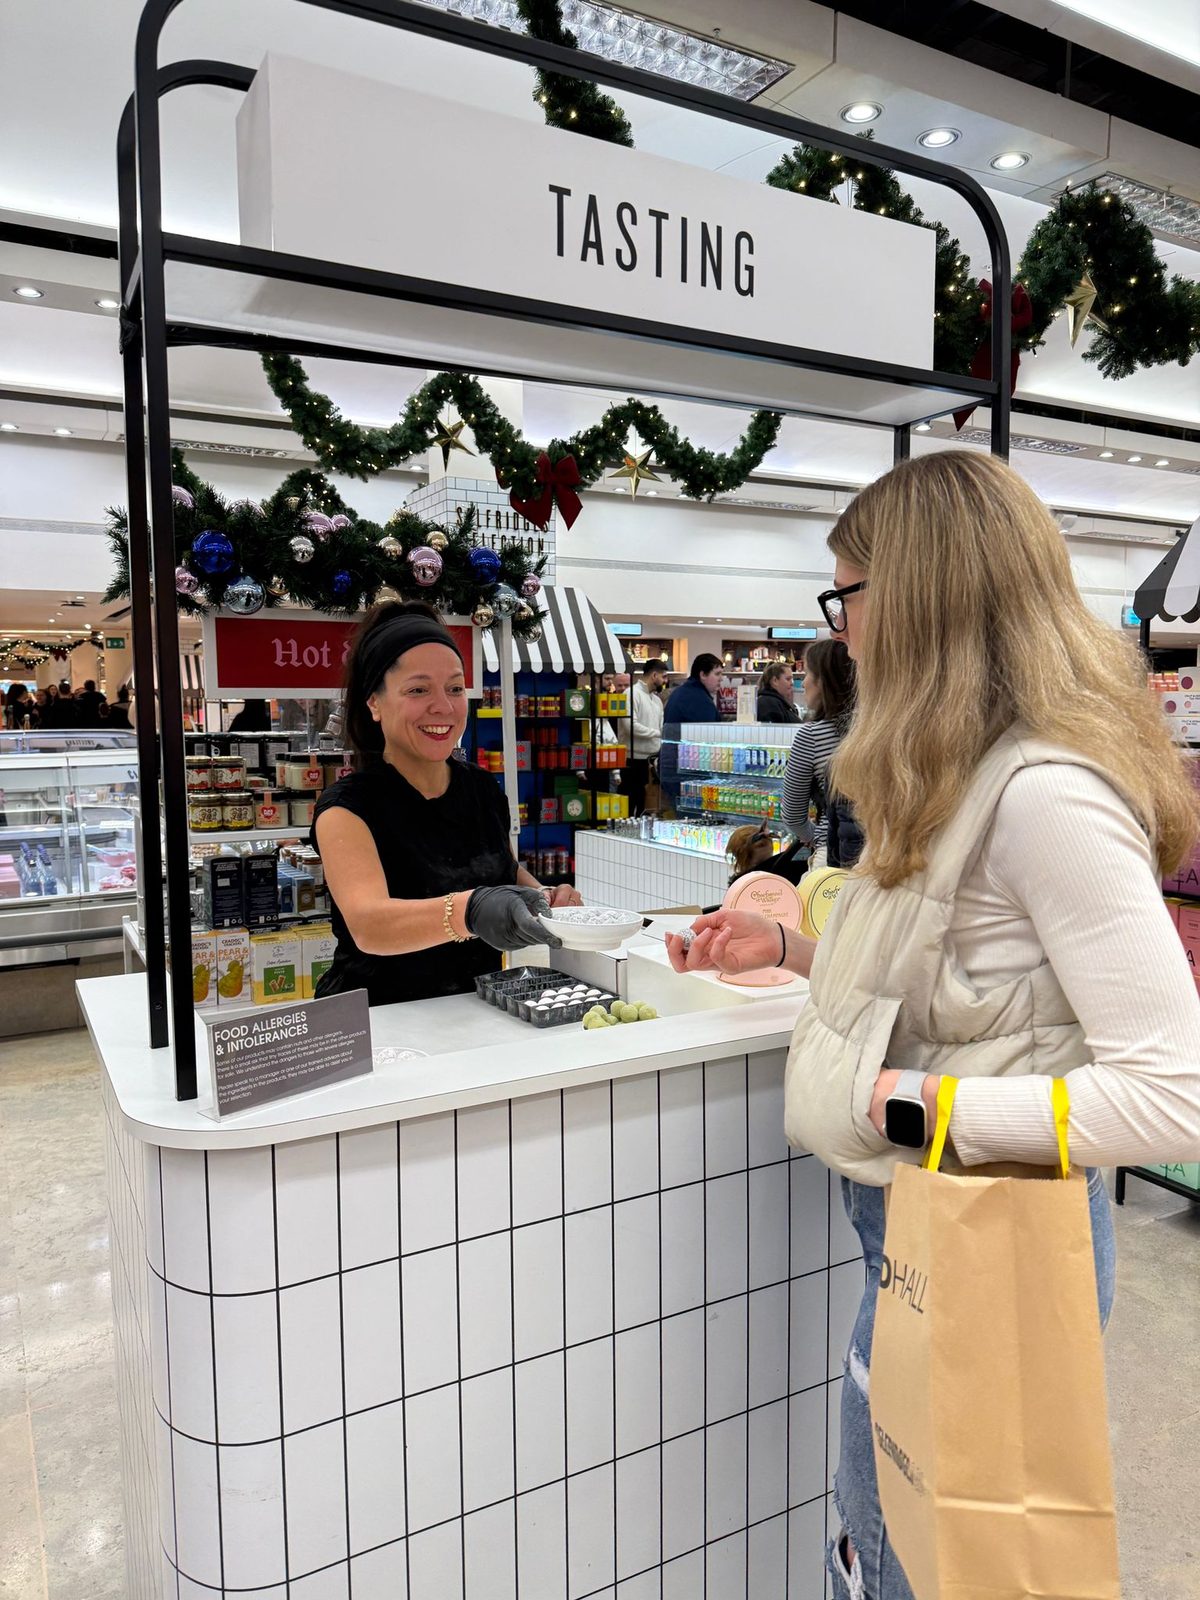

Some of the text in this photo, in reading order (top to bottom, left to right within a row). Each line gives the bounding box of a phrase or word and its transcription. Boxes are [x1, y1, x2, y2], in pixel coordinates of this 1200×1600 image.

[549, 184, 754, 297] TASTING
[271, 638, 331, 668] Hot
[218, 946, 249, 957] PEAR &
[214, 1011, 307, 1042] FOOD ALLERGIES
[215, 1023, 308, 1055] & INTOLERANCES
